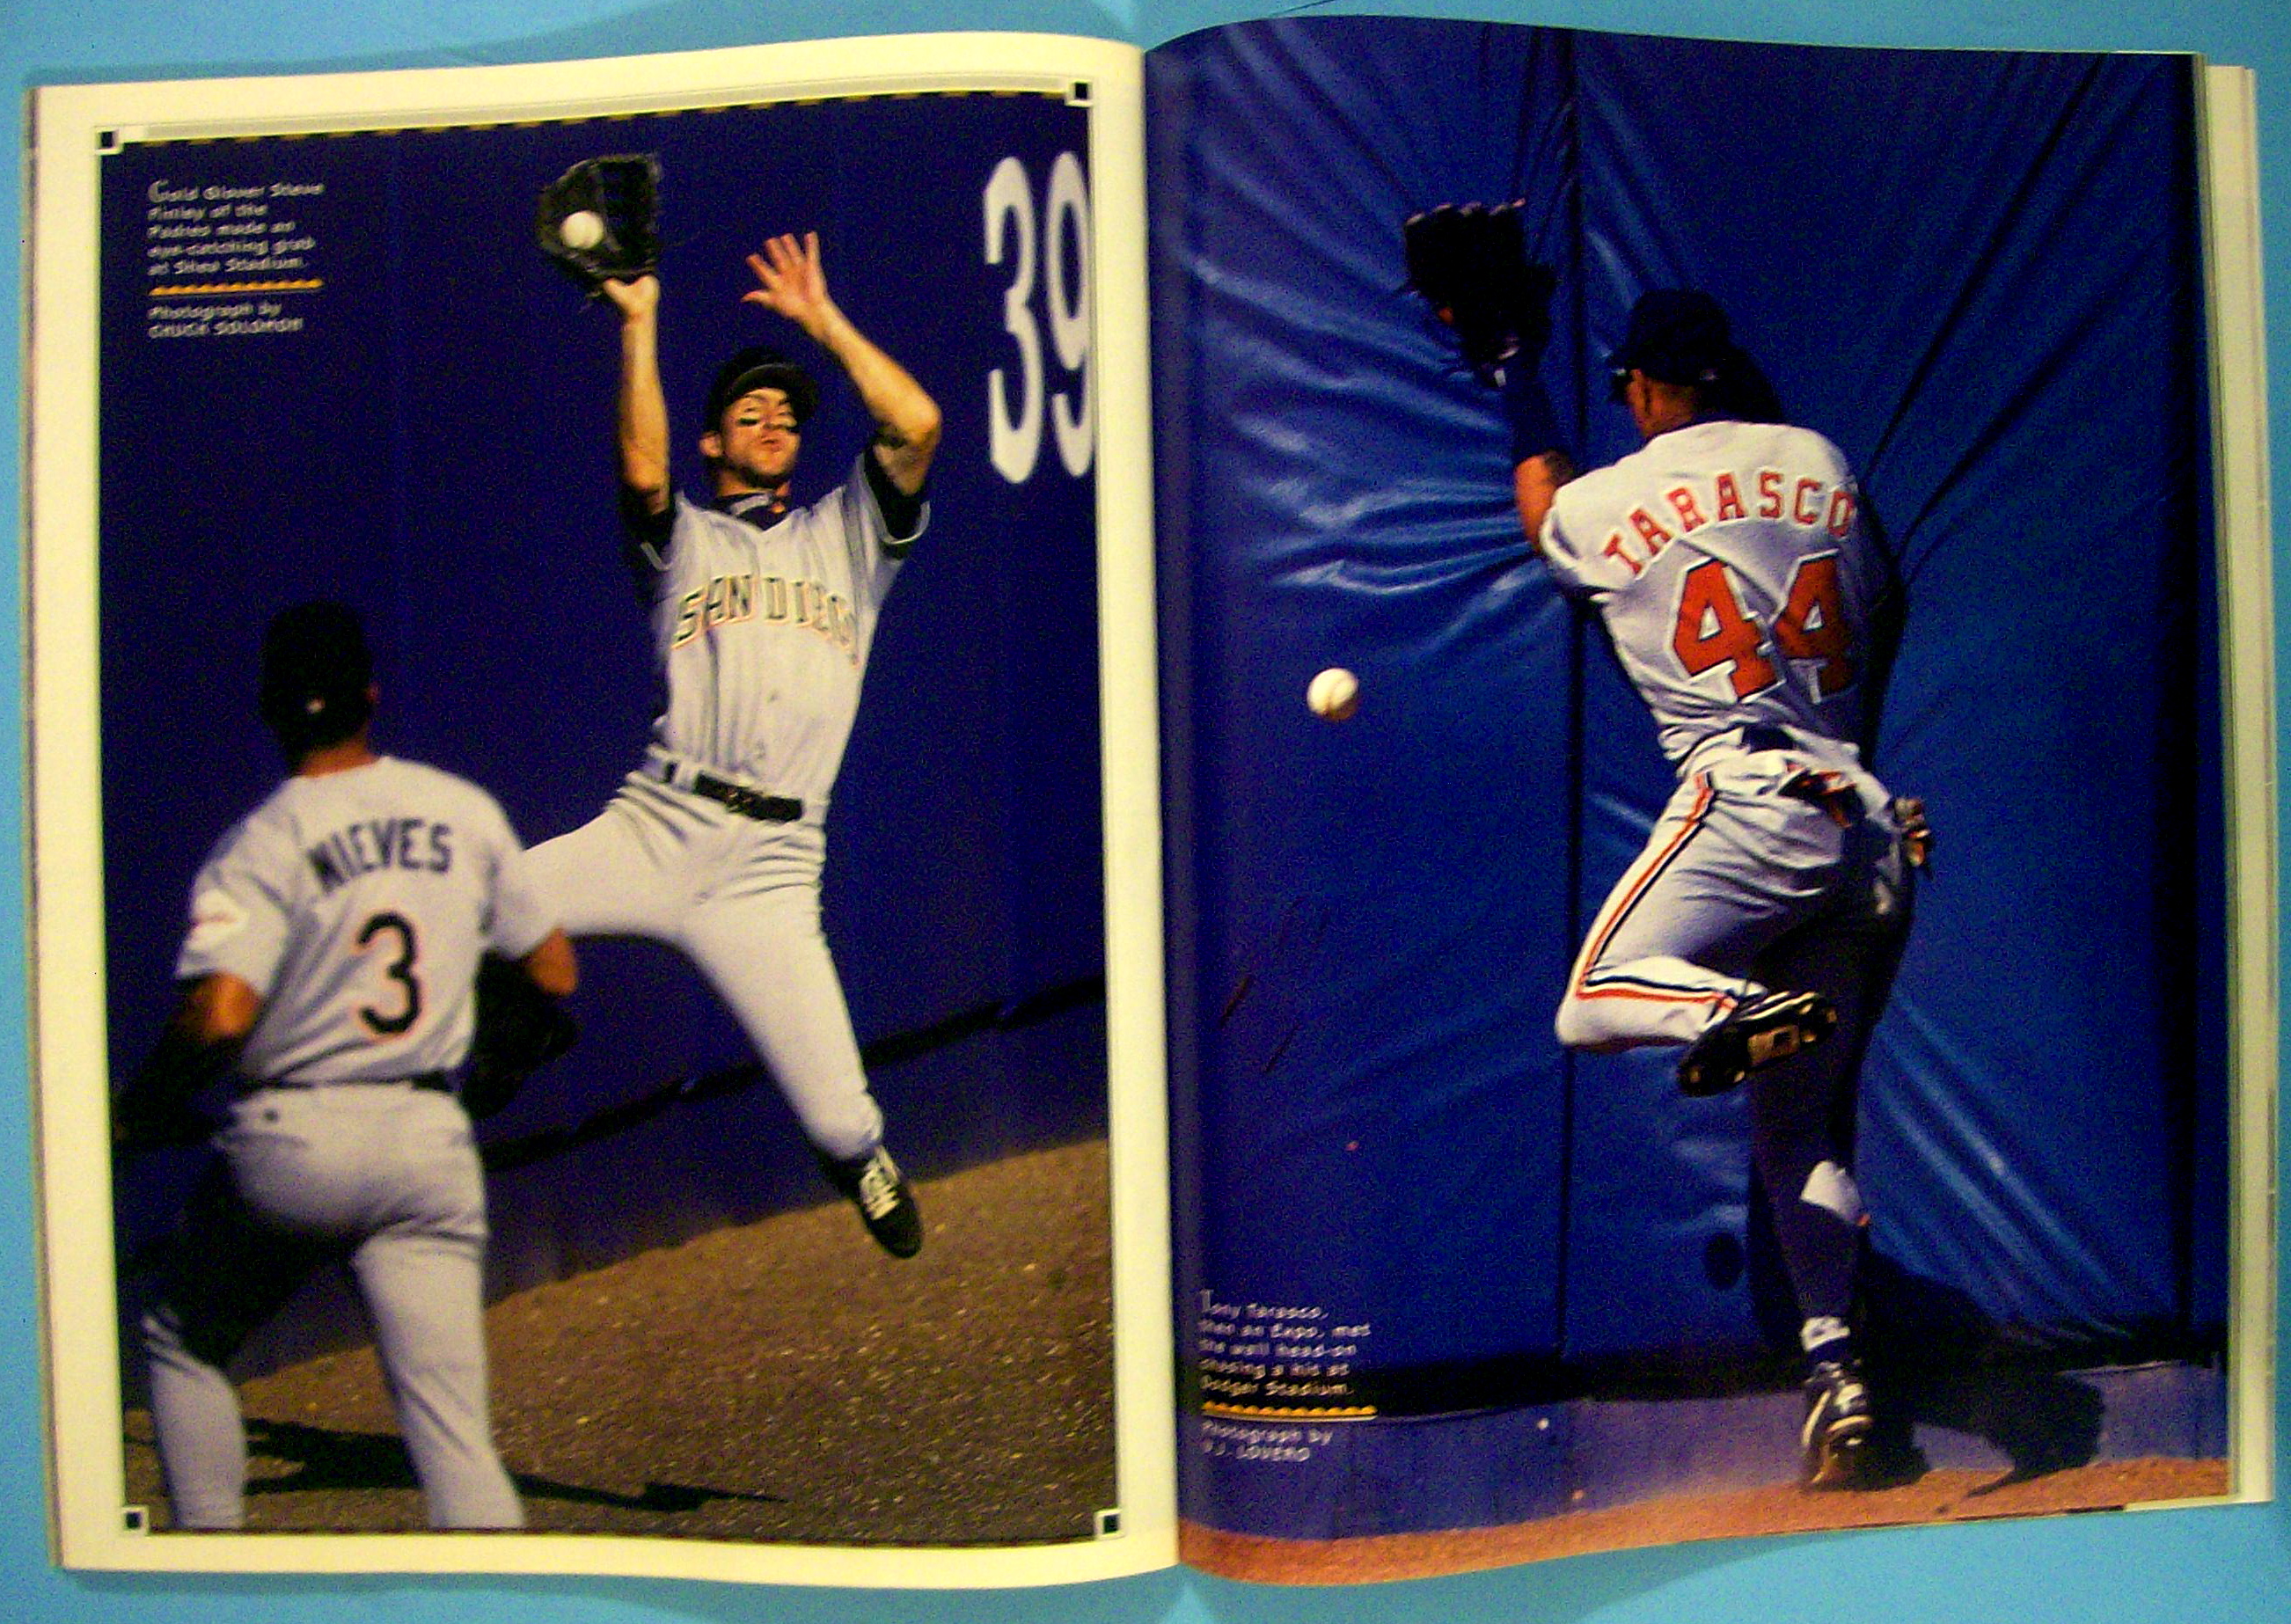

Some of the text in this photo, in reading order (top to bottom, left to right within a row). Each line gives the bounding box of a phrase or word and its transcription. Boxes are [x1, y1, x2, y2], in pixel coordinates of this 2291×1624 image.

[234, 204, 267, 217] the
[258, 302, 282, 317] by
[984, 151, 1093, 484] 39
[1601, 469, 1858, 582] TARASCO
[671, 574, 758, 649] SAN
[1672, 547, 1856, 704] 44
[305, 817, 452, 896] NIEVES
[355, 911, 423, 1036] 3
